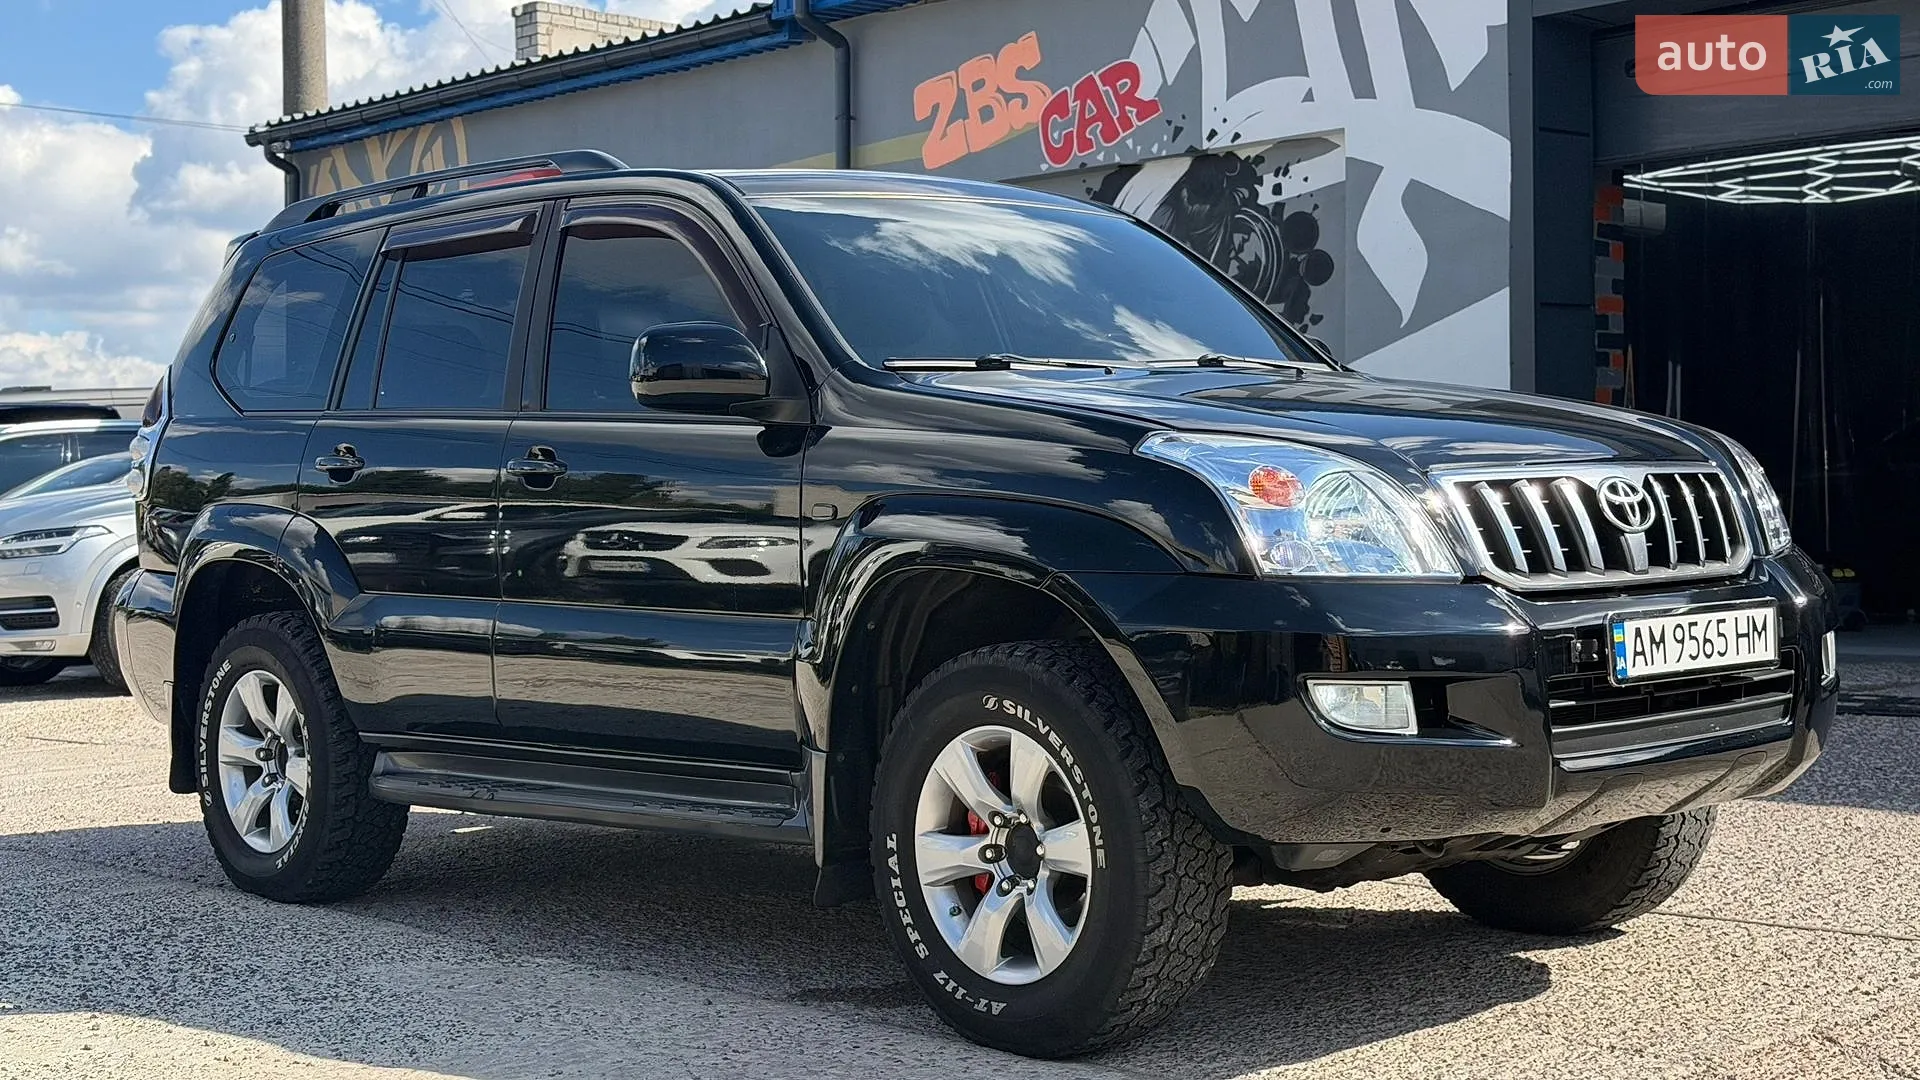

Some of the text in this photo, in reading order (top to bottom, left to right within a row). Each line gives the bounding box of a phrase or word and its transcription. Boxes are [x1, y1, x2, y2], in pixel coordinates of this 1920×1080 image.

[913, 30, 1163, 170] ZBS CAR
[1632, 613, 1768, 668] AM 9565 HM
[199, 658, 233, 788] SILVERSTONE
[1002, 699, 1107, 870] SILVERSTONE
[886, 832, 1008, 1017] AT-117 SPECIAL
